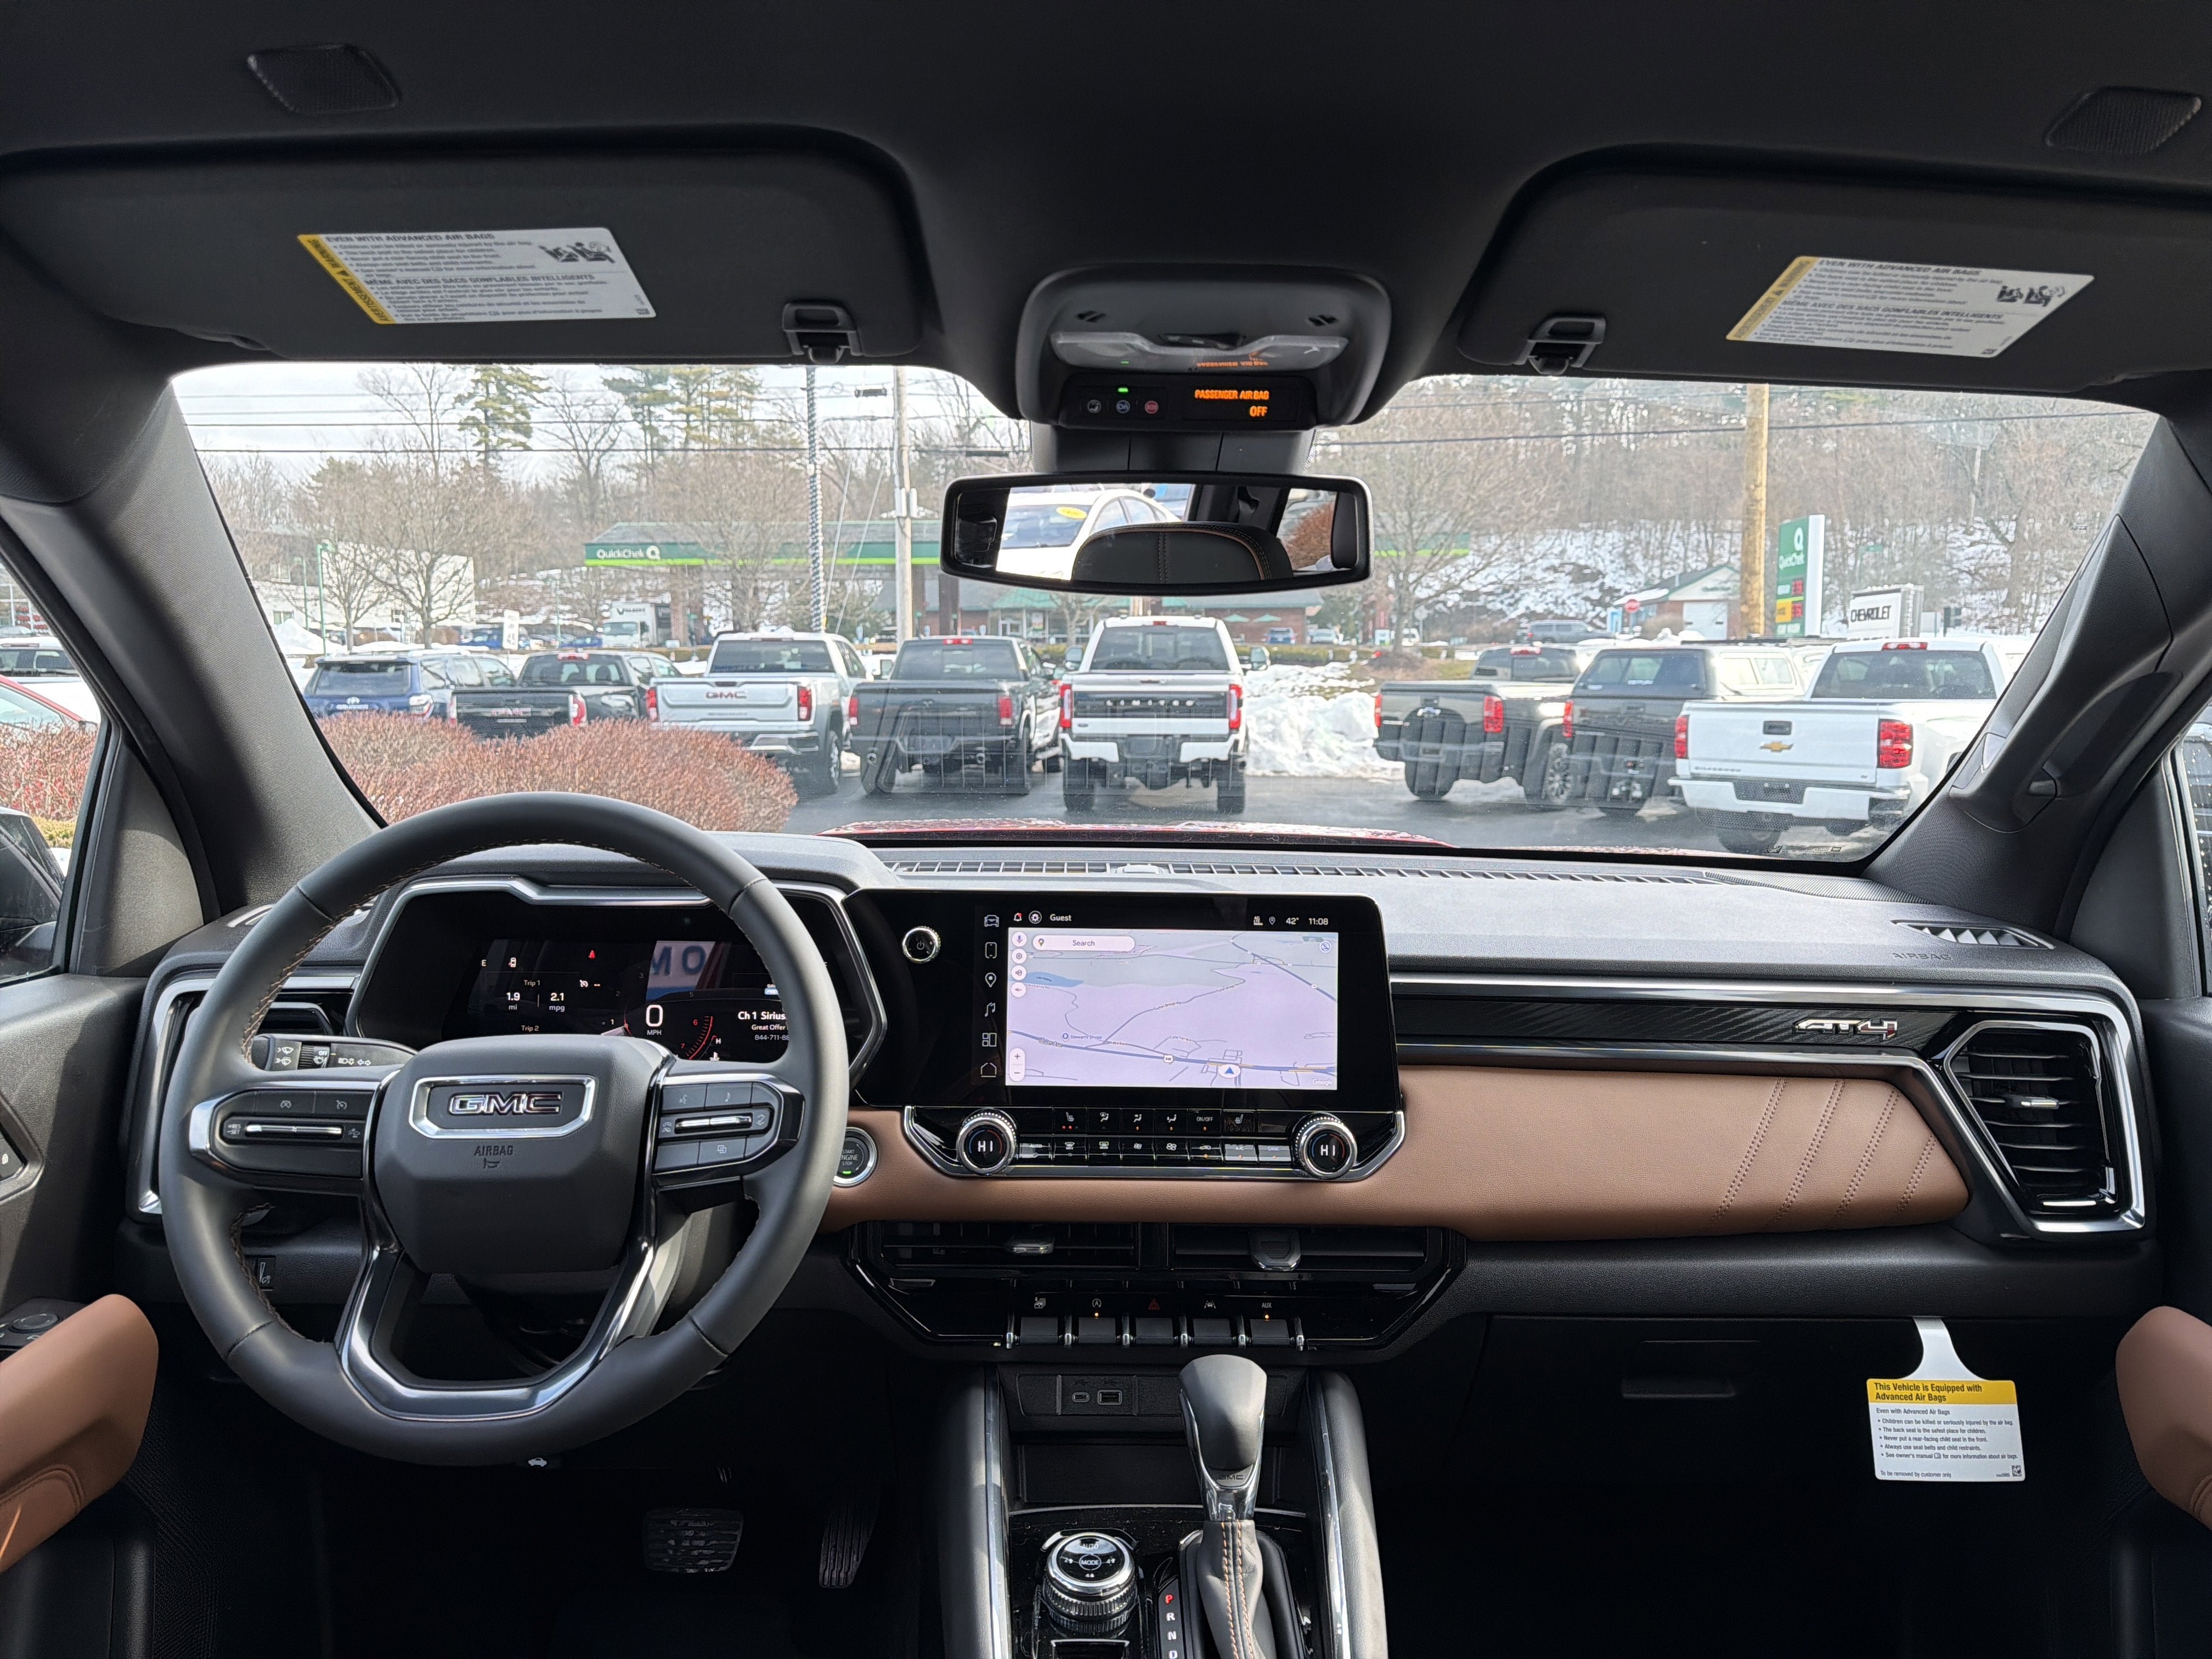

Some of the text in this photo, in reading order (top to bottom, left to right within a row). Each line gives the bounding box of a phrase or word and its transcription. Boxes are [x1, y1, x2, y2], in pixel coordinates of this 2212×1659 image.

[1876, 263, 1932, 273] ADVANCED
[1195, 390, 1269, 400] PASSENGER AIR BAG
[1249, 405, 1268, 417] OFF
[596, 548, 645, 560] QuickChek
[1850, 605, 1892, 623] CHEVROLET
[706, 691, 748, 699] GMC
[1049, 913, 1072, 922] Guest
[1286, 917, 1299, 925] 42°
[506, 992, 521, 1001] 1.9
[550, 992, 565, 1001] 2.1
[646, 1005, 663, 1027] 0
[738, 1011, 787, 1020] Ch 1 Sirius
[1792, 1017, 1898, 1042] AT4
[449, 1091, 563, 1115] GMC
[474, 1145, 514, 1156] AIRBAG
[978, 1141, 993, 1152] HI
[1321, 1144, 1335, 1156] HI
[1922, 1383, 1929, 1391] is
[1931, 1384, 1965, 1393] Equipped
[1876, 1392, 1913, 1401] Advanced
[1928, 1393, 1946, 1403] Bags
[1165, 1594, 1173, 1605] P
[1166, 1612, 1176, 1621] R
[1167, 1630, 1177, 1640] N
[1169, 1650, 1178, 1659] D
